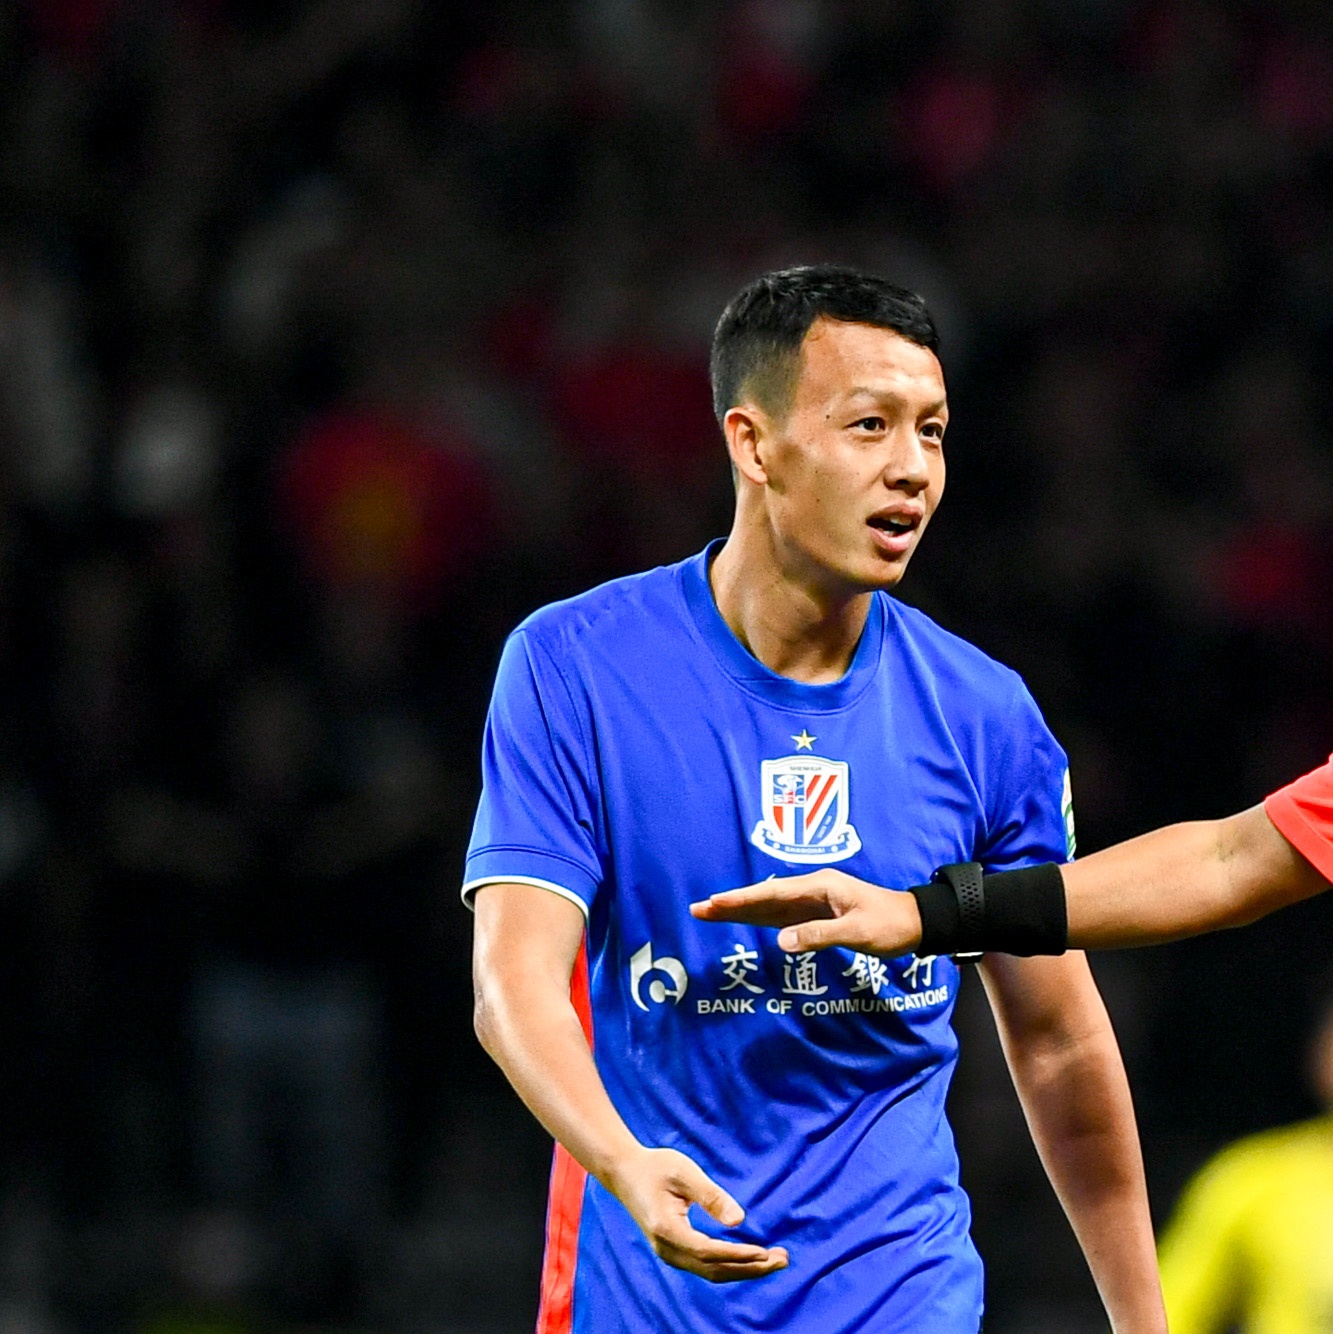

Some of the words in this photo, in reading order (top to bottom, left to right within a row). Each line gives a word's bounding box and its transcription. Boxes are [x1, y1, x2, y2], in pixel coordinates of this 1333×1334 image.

[719, 943, 938, 996] 交通銀行
[697, 998, 756, 1015] BANK
[766, 998, 793, 1015] OF
[802, 985, 949, 1017] COMMUNICATIONS
